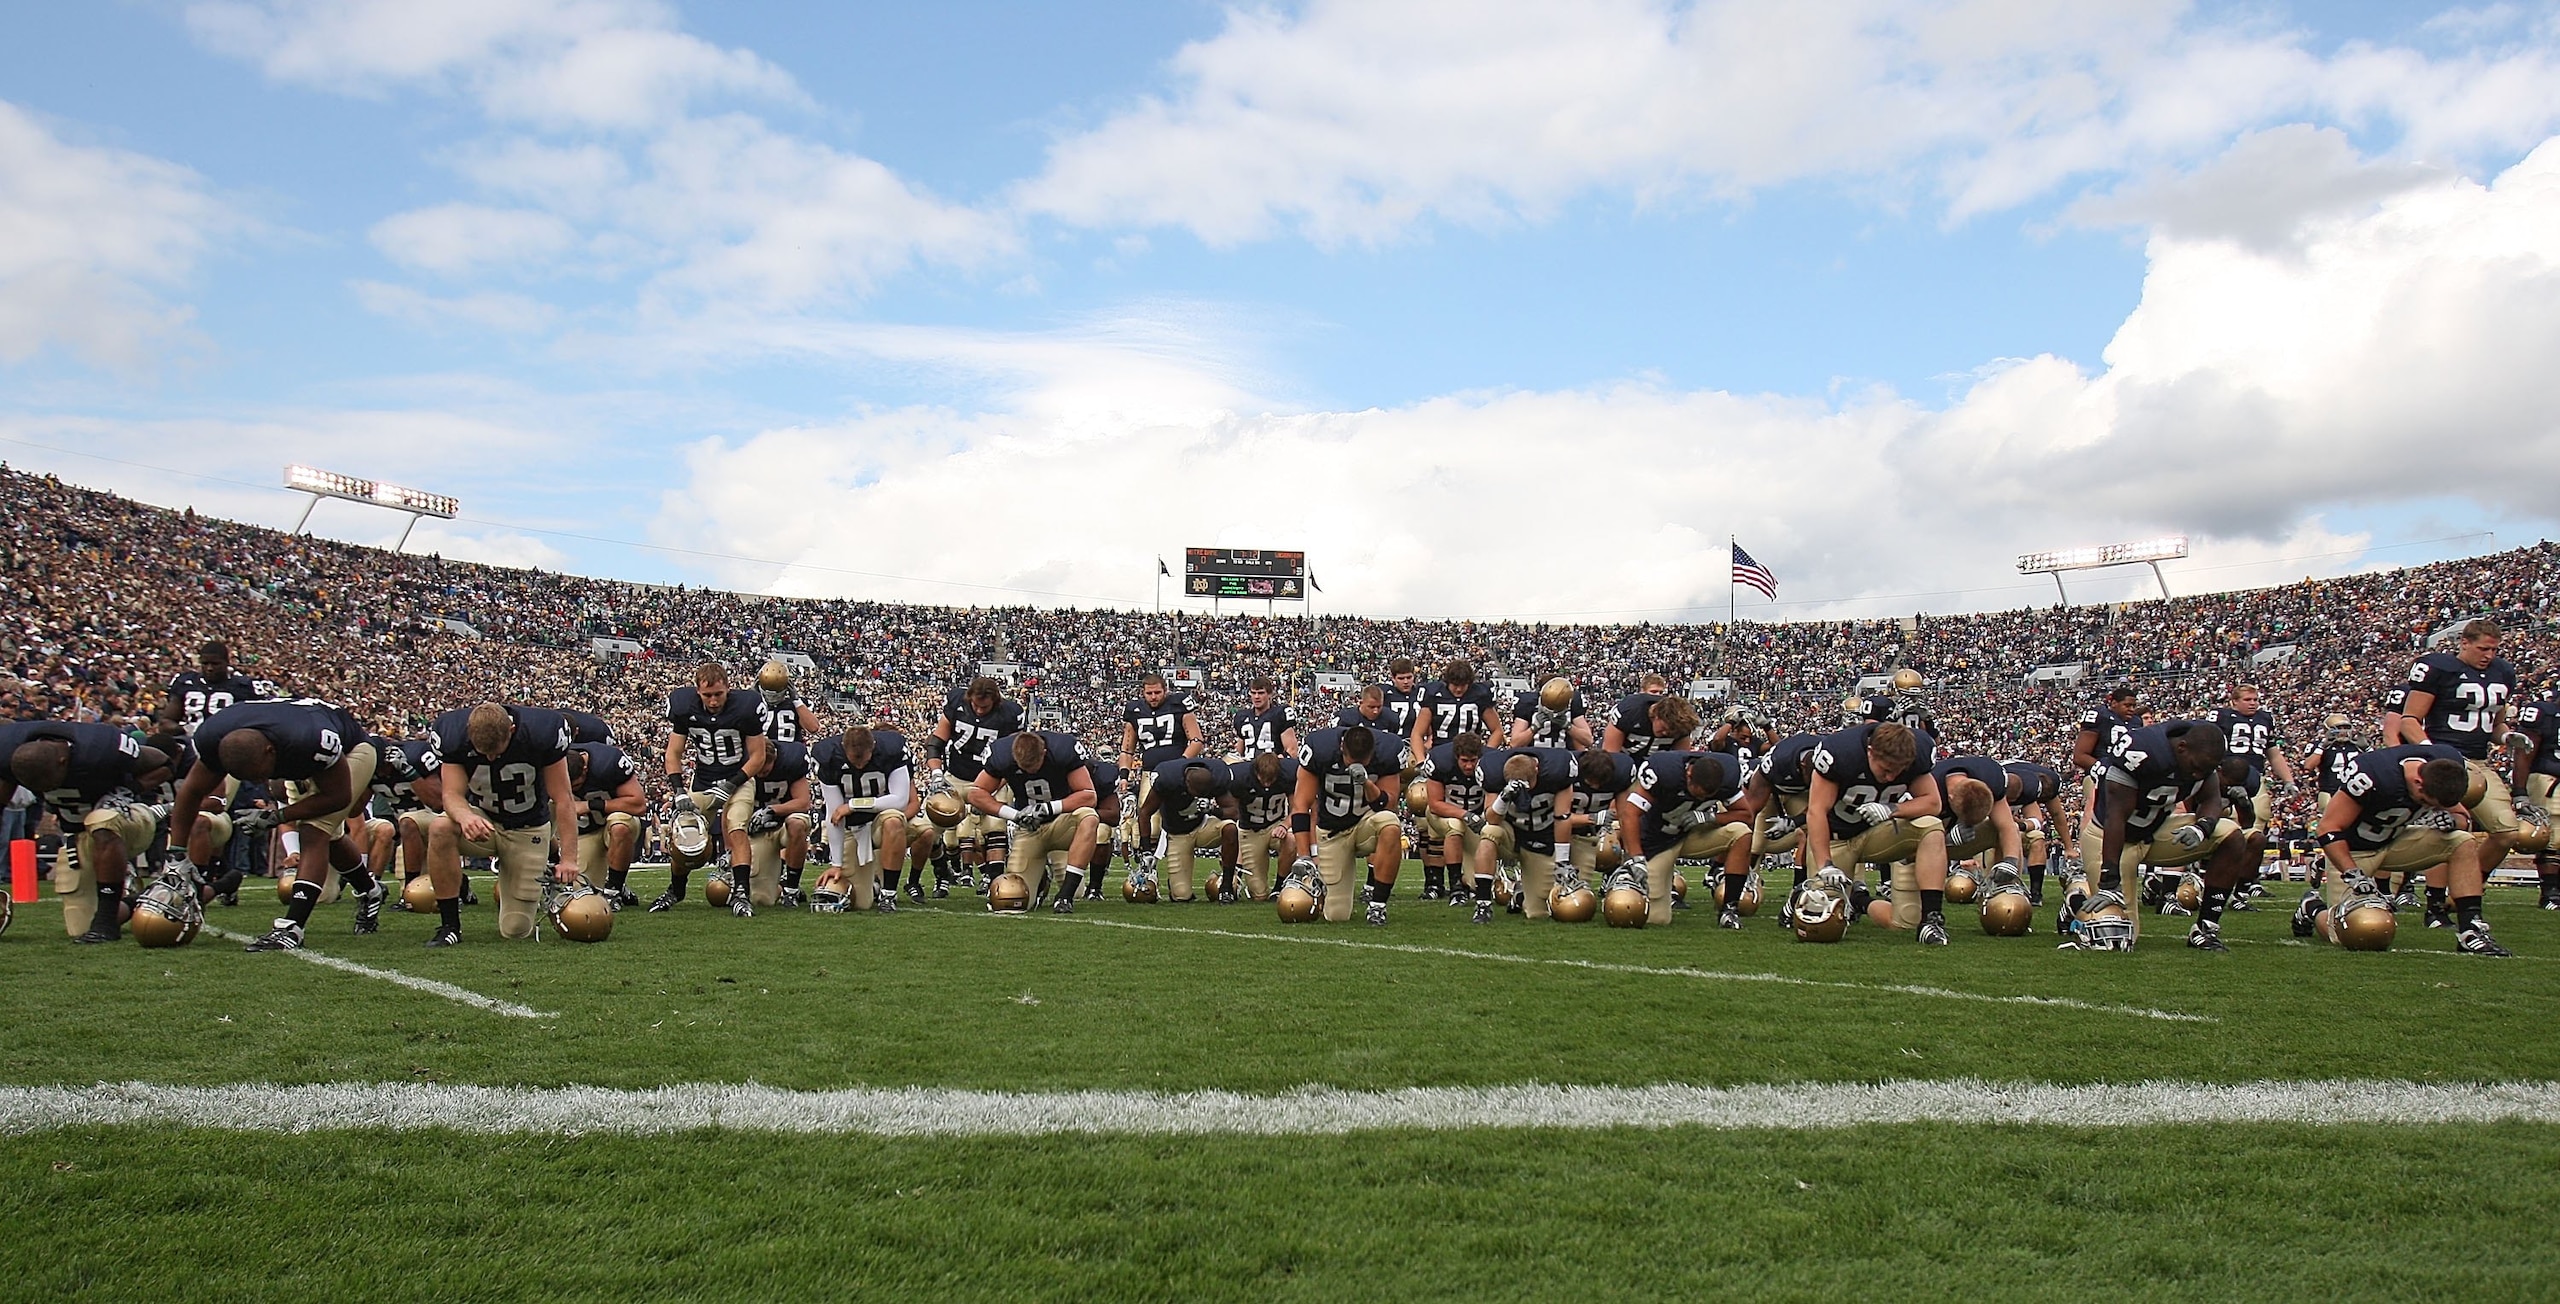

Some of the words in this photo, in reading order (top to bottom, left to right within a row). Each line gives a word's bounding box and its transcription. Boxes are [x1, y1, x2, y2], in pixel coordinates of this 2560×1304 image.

[1284, 706, 1297, 721] 2
[1437, 703, 1480, 738] 70
[2447, 682, 2509, 733] 36
[119, 733, 141, 759] 5
[953, 720, 999, 761] 77
[1137, 713, 1175, 750] 57
[1241, 721, 1275, 758] 24
[421, 751, 443, 772] 2
[1298, 739, 1313, 767] 0
[2113, 734, 2148, 771] 34
[468, 762, 537, 814] 43
[841, 771, 886, 798] 10
[1637, 760, 1658, 790] 3
[2340, 760, 2374, 797] 38
